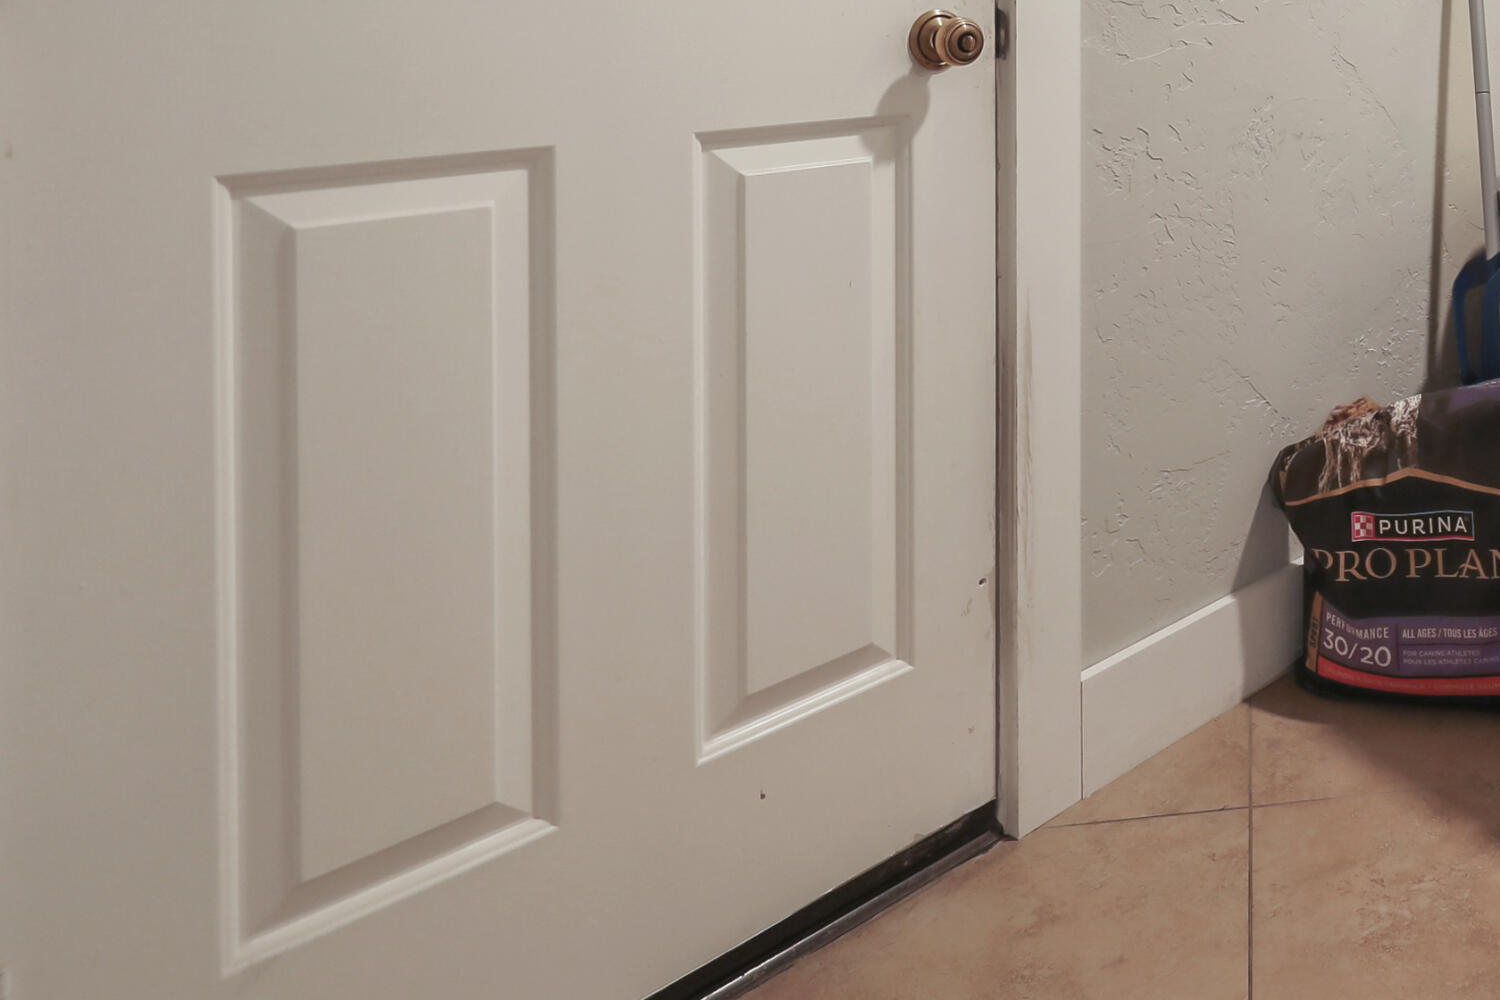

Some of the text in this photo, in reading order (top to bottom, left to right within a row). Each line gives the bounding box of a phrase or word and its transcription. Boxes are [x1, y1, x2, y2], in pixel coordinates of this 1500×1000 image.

[1379, 516, 1468, 535] PURINA
[1402, 628, 1417, 639] ALL
[1417, 627, 1438, 639] AGES
[1443, 627, 1462, 639] TOUS
[1463, 627, 1477, 639] LES
[1322, 627, 1392, 668] 30/20
